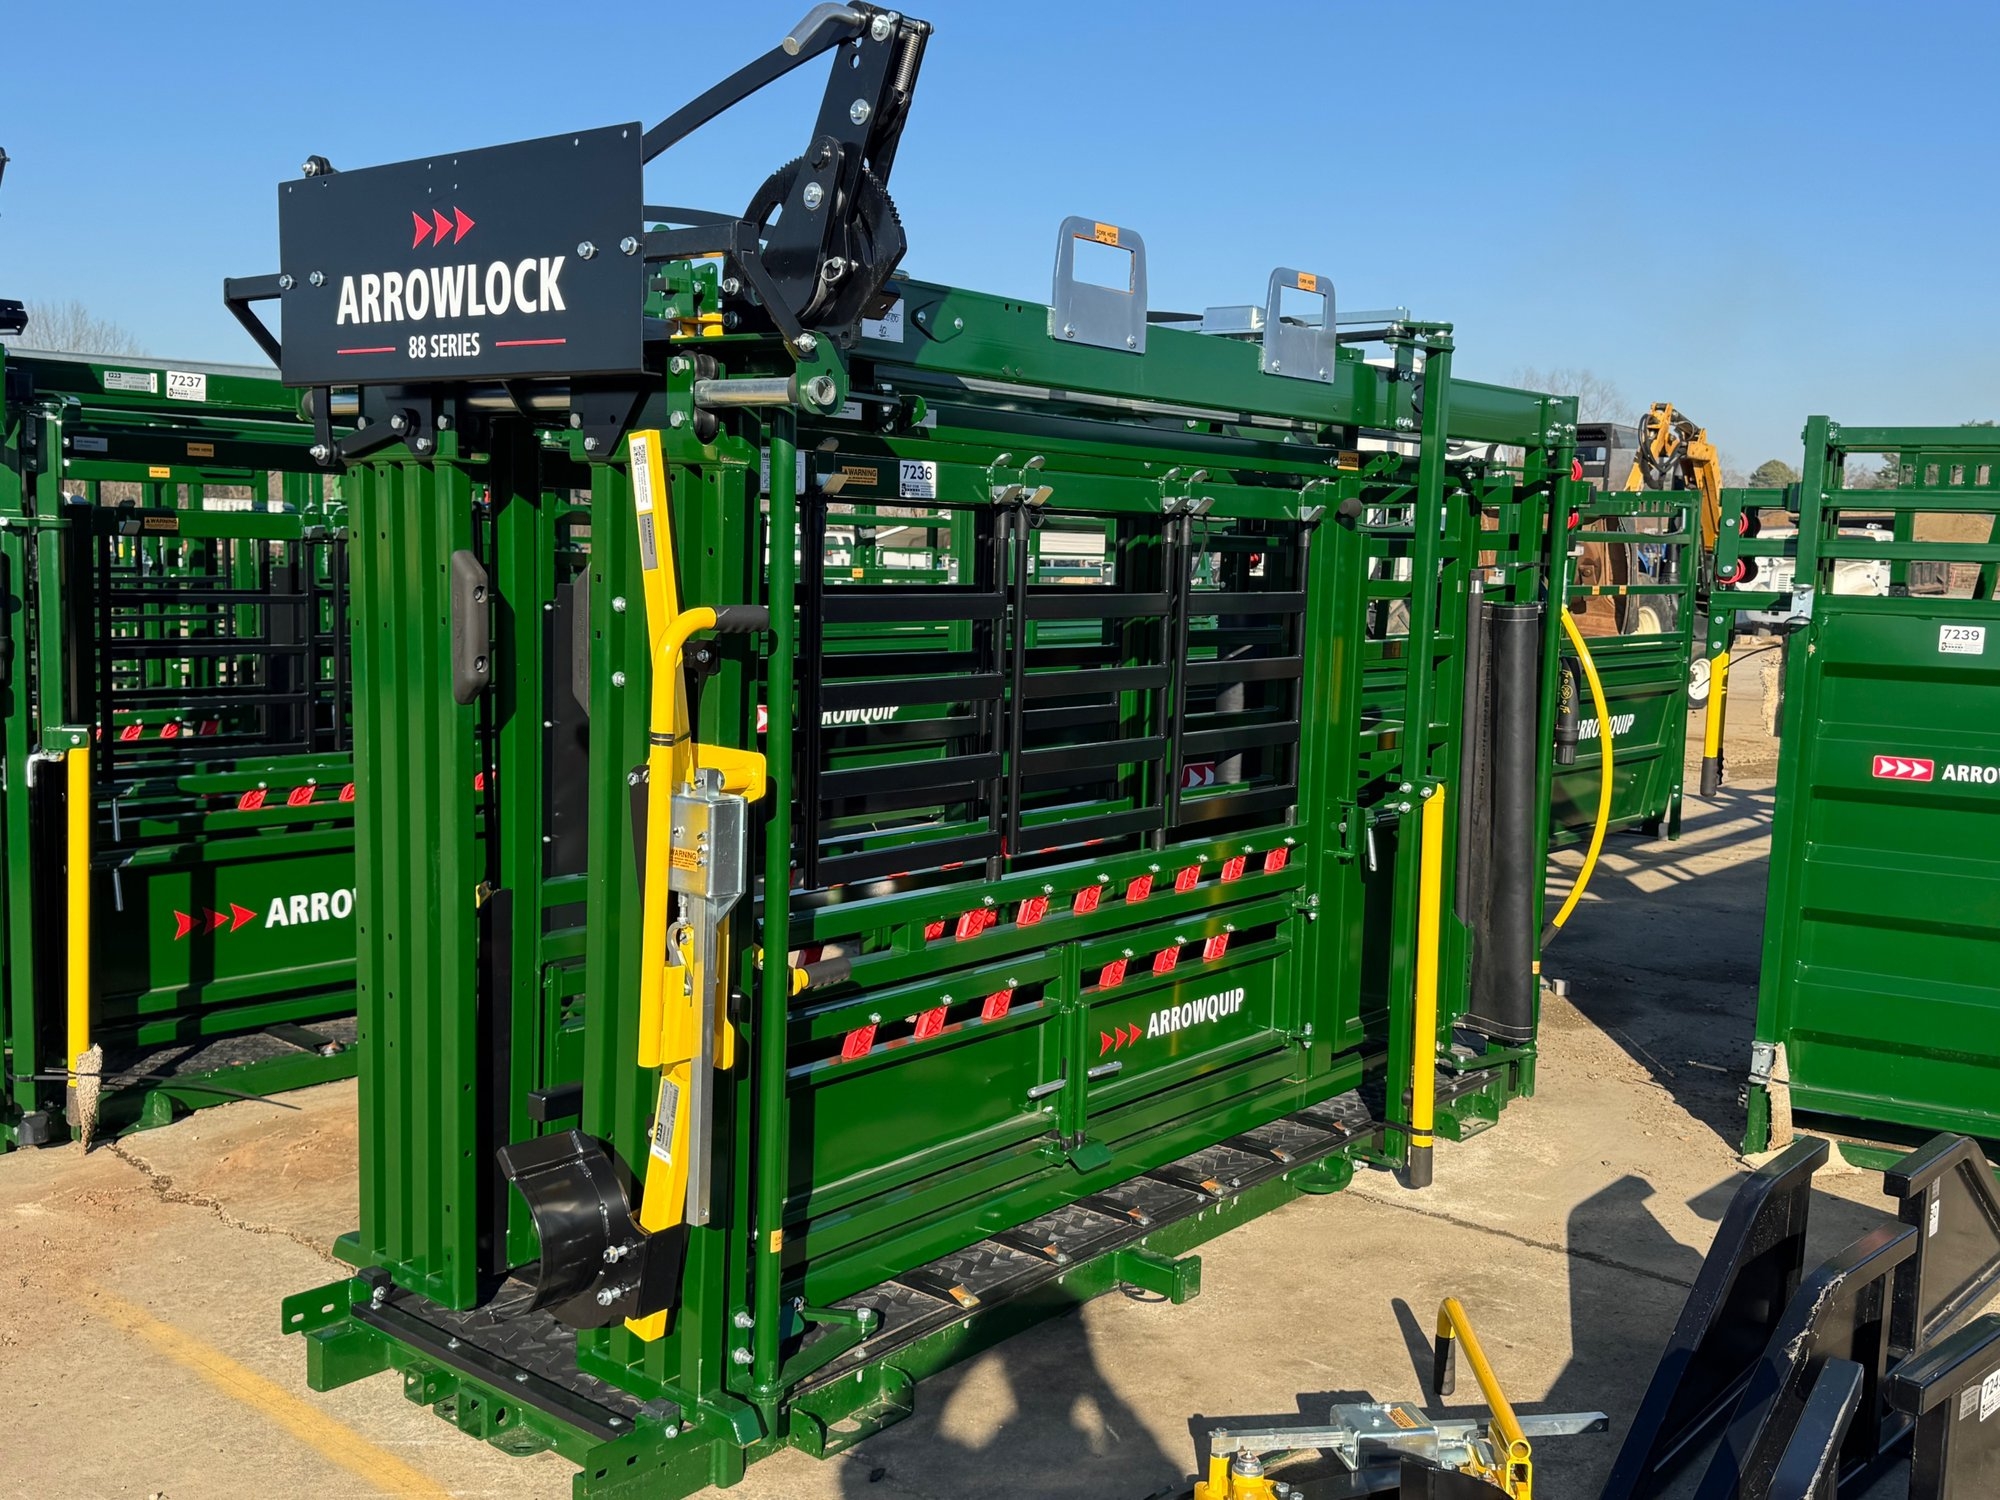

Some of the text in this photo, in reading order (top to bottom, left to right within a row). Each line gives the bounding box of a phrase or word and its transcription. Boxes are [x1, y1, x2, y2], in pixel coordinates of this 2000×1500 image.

[336, 256, 566, 325] ARROWLOCK
[408, 332, 481, 359] 88 SERIES
[170, 374, 202, 388] 7237
[849, 467, 877, 478] WARNING
[902, 464, 933, 480] 7236
[151, 517, 177, 525] WARNING
[1944, 628, 1980, 641] 7239
[1577, 713, 1635, 740] RROQUIP
[1941, 763, 2000, 784] ARRO
[264, 887, 356, 929] ARRO
[1146, 987, 1245, 1040] ARROWQUIP
[1983, 1374, 2000, 1400] 724
